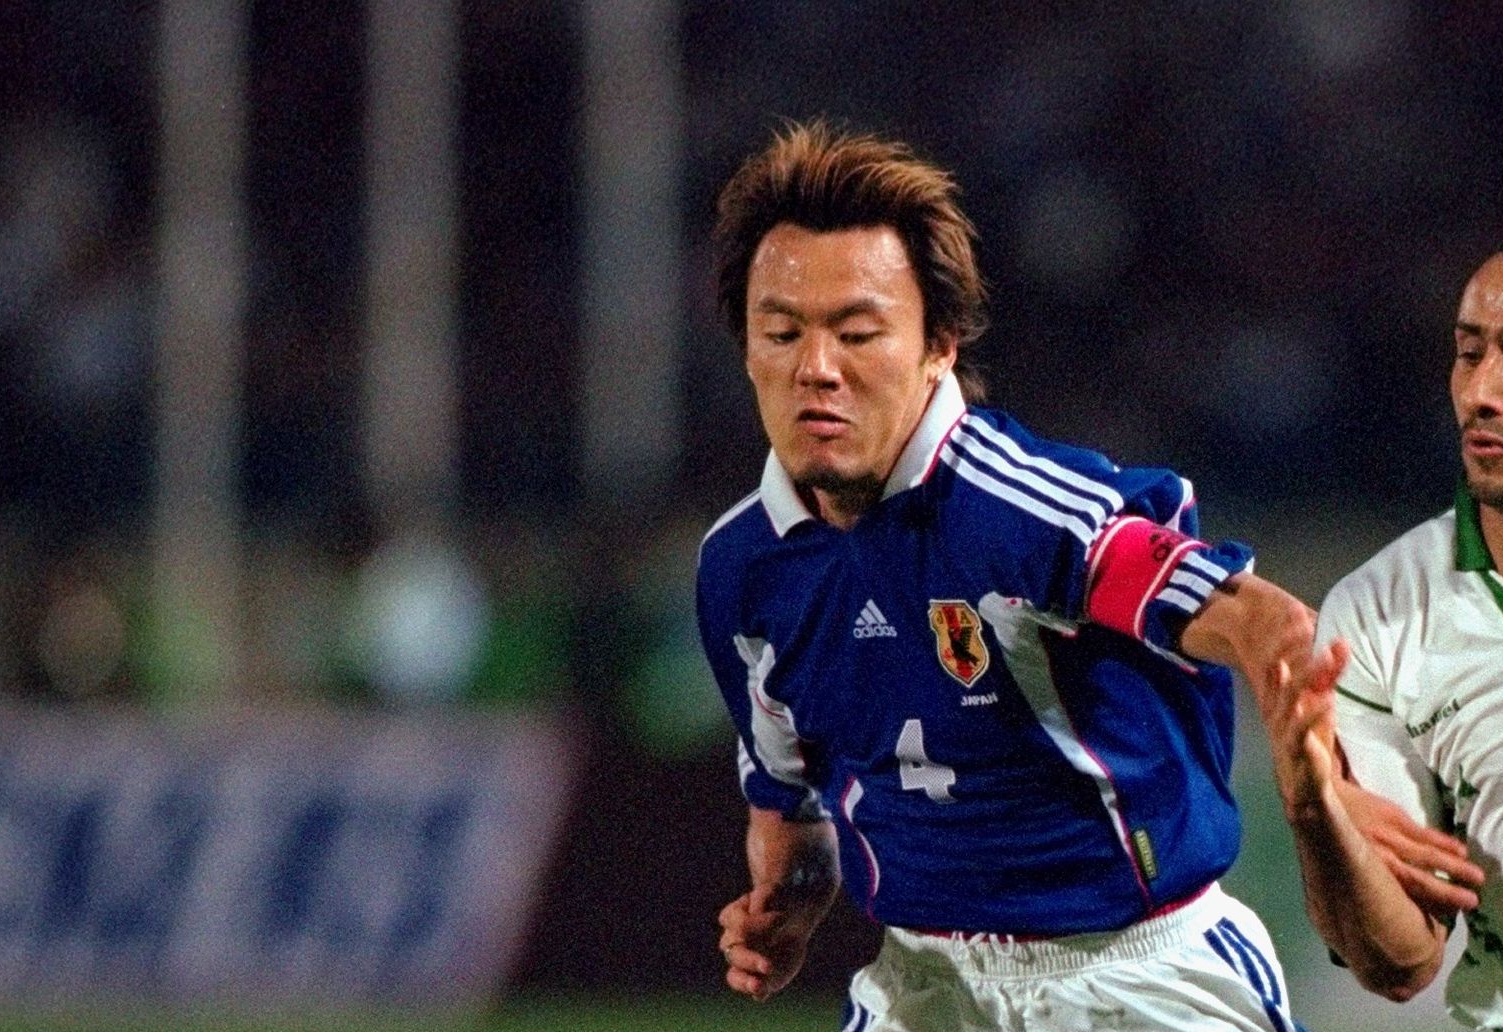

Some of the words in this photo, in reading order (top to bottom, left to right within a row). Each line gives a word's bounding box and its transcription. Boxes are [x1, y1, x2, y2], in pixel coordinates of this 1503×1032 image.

[853, 625, 898, 639] adidas
[960, 692, 999, 707] JAPAN
[895, 719, 958, 804] 4
